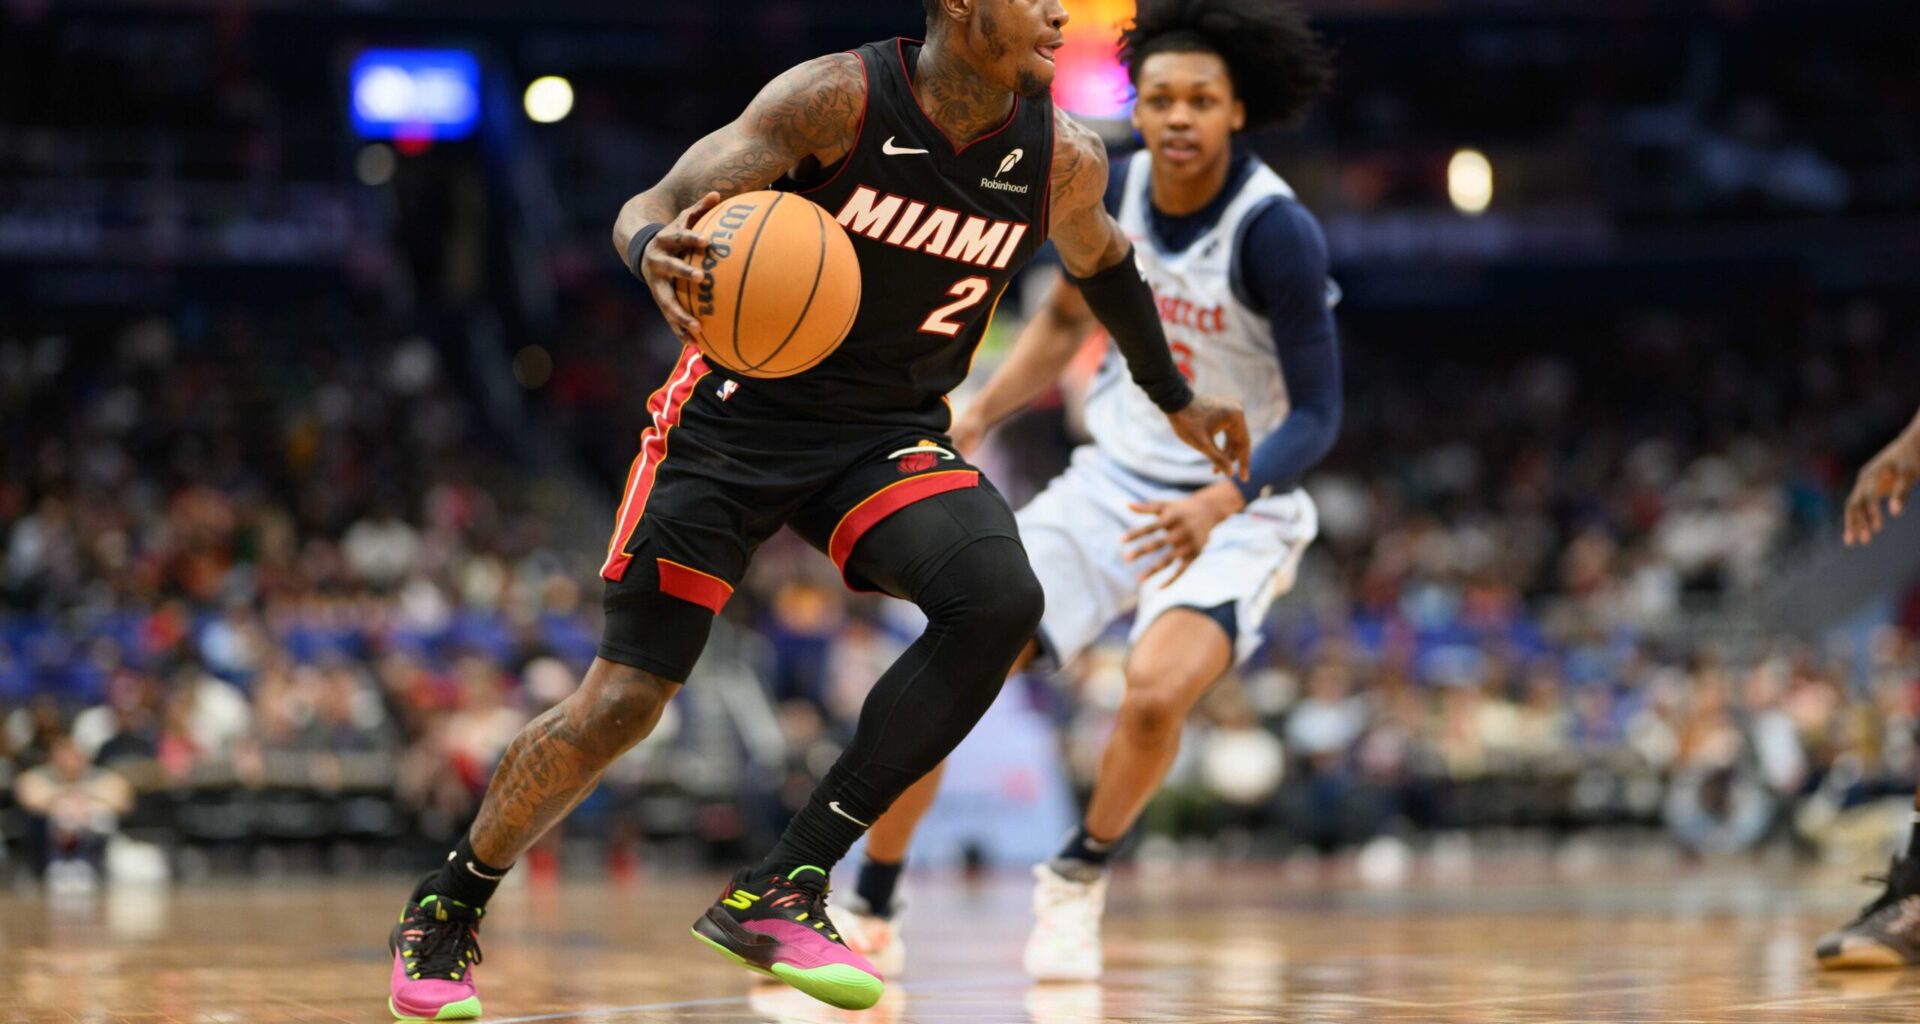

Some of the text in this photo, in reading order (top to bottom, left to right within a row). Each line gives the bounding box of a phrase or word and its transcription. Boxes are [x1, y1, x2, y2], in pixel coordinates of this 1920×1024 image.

[980, 177, 1029, 194] Robinhood
[698, 203, 758, 316] Wilson
[835, 184, 1030, 270] MIAMI
[917, 274, 991, 338] 2
